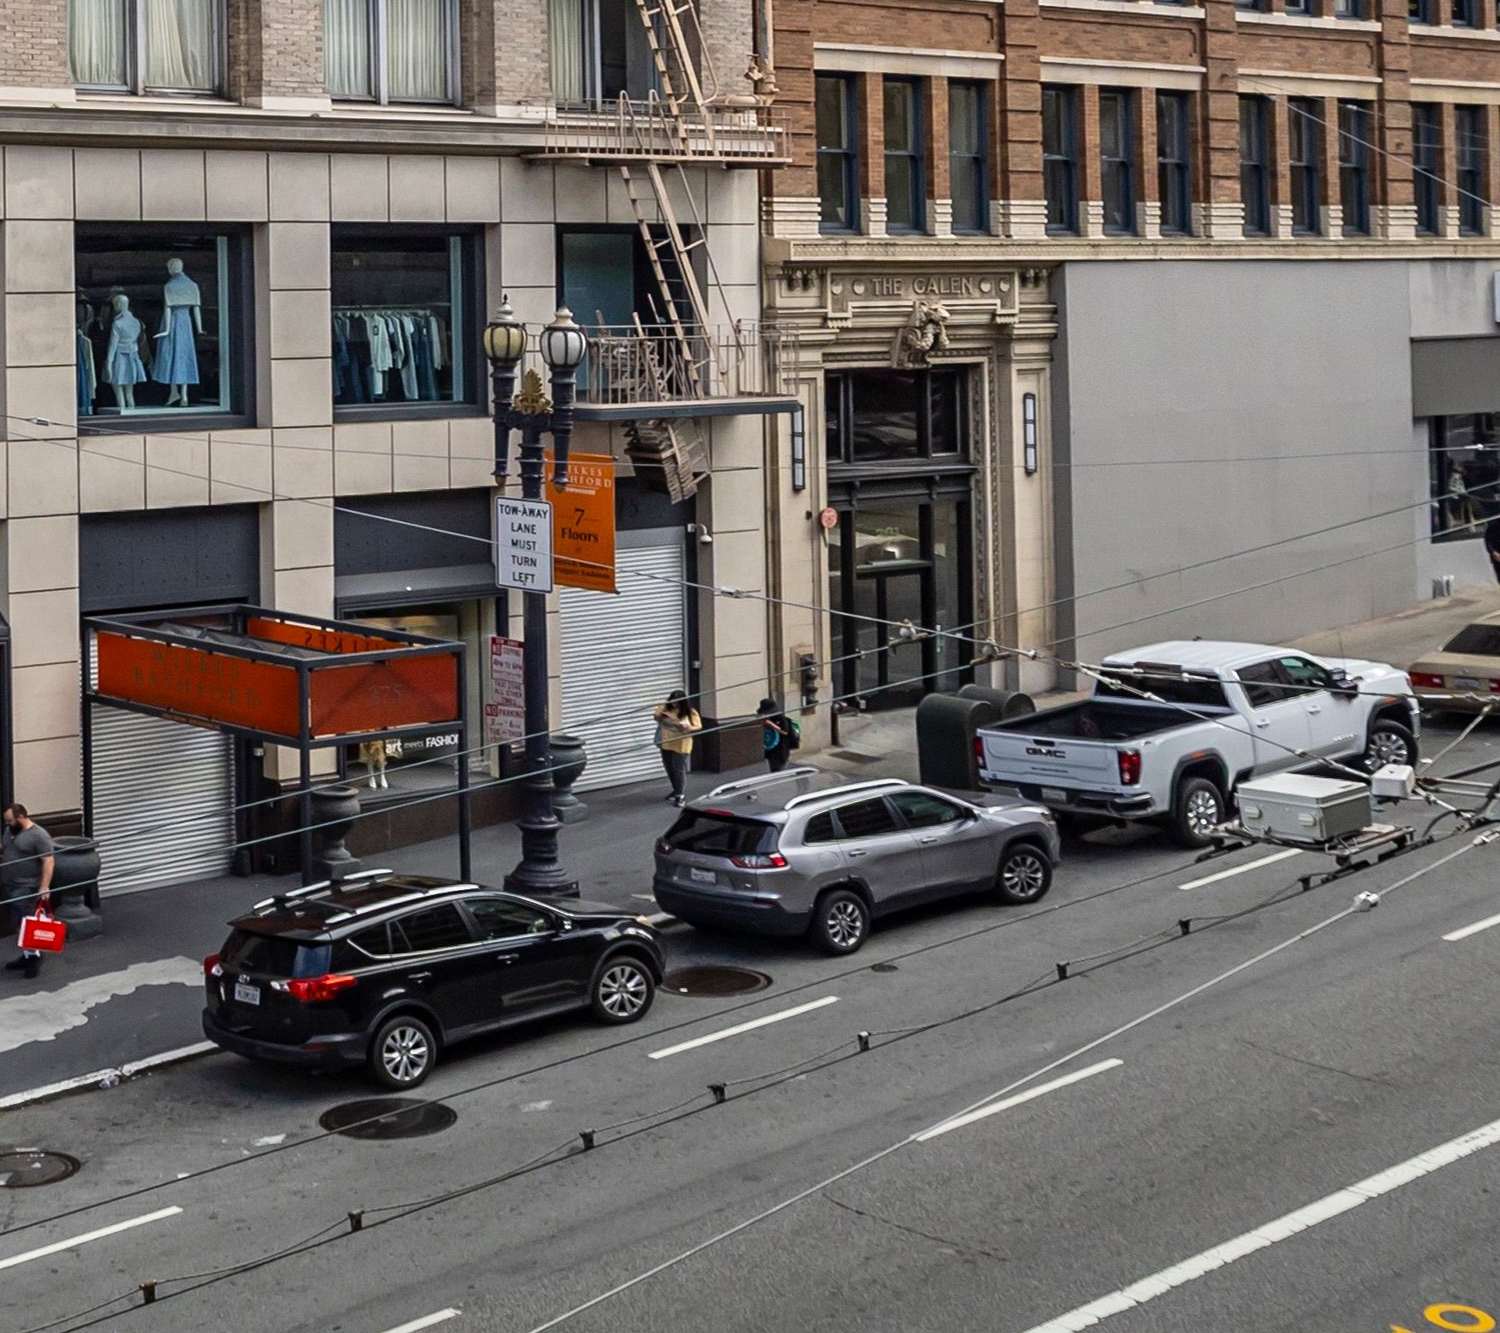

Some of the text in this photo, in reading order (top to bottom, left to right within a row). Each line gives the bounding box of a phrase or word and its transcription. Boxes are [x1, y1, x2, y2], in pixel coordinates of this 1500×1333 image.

[872, 277, 904, 295] THE
[567, 464, 603, 477] ILKES
[498, 503, 549, 520] TOW-AWAY
[574, 507, 585, 526] 7
[510, 521, 537, 535] LANE
[561, 527, 599, 543] Floors
[510, 538, 537, 551] MUST
[510, 554, 538, 568] TURN
[512, 571, 536, 584] LEFT
[385, 740, 402, 754] art
[1025, 747, 1067, 759] GMC
